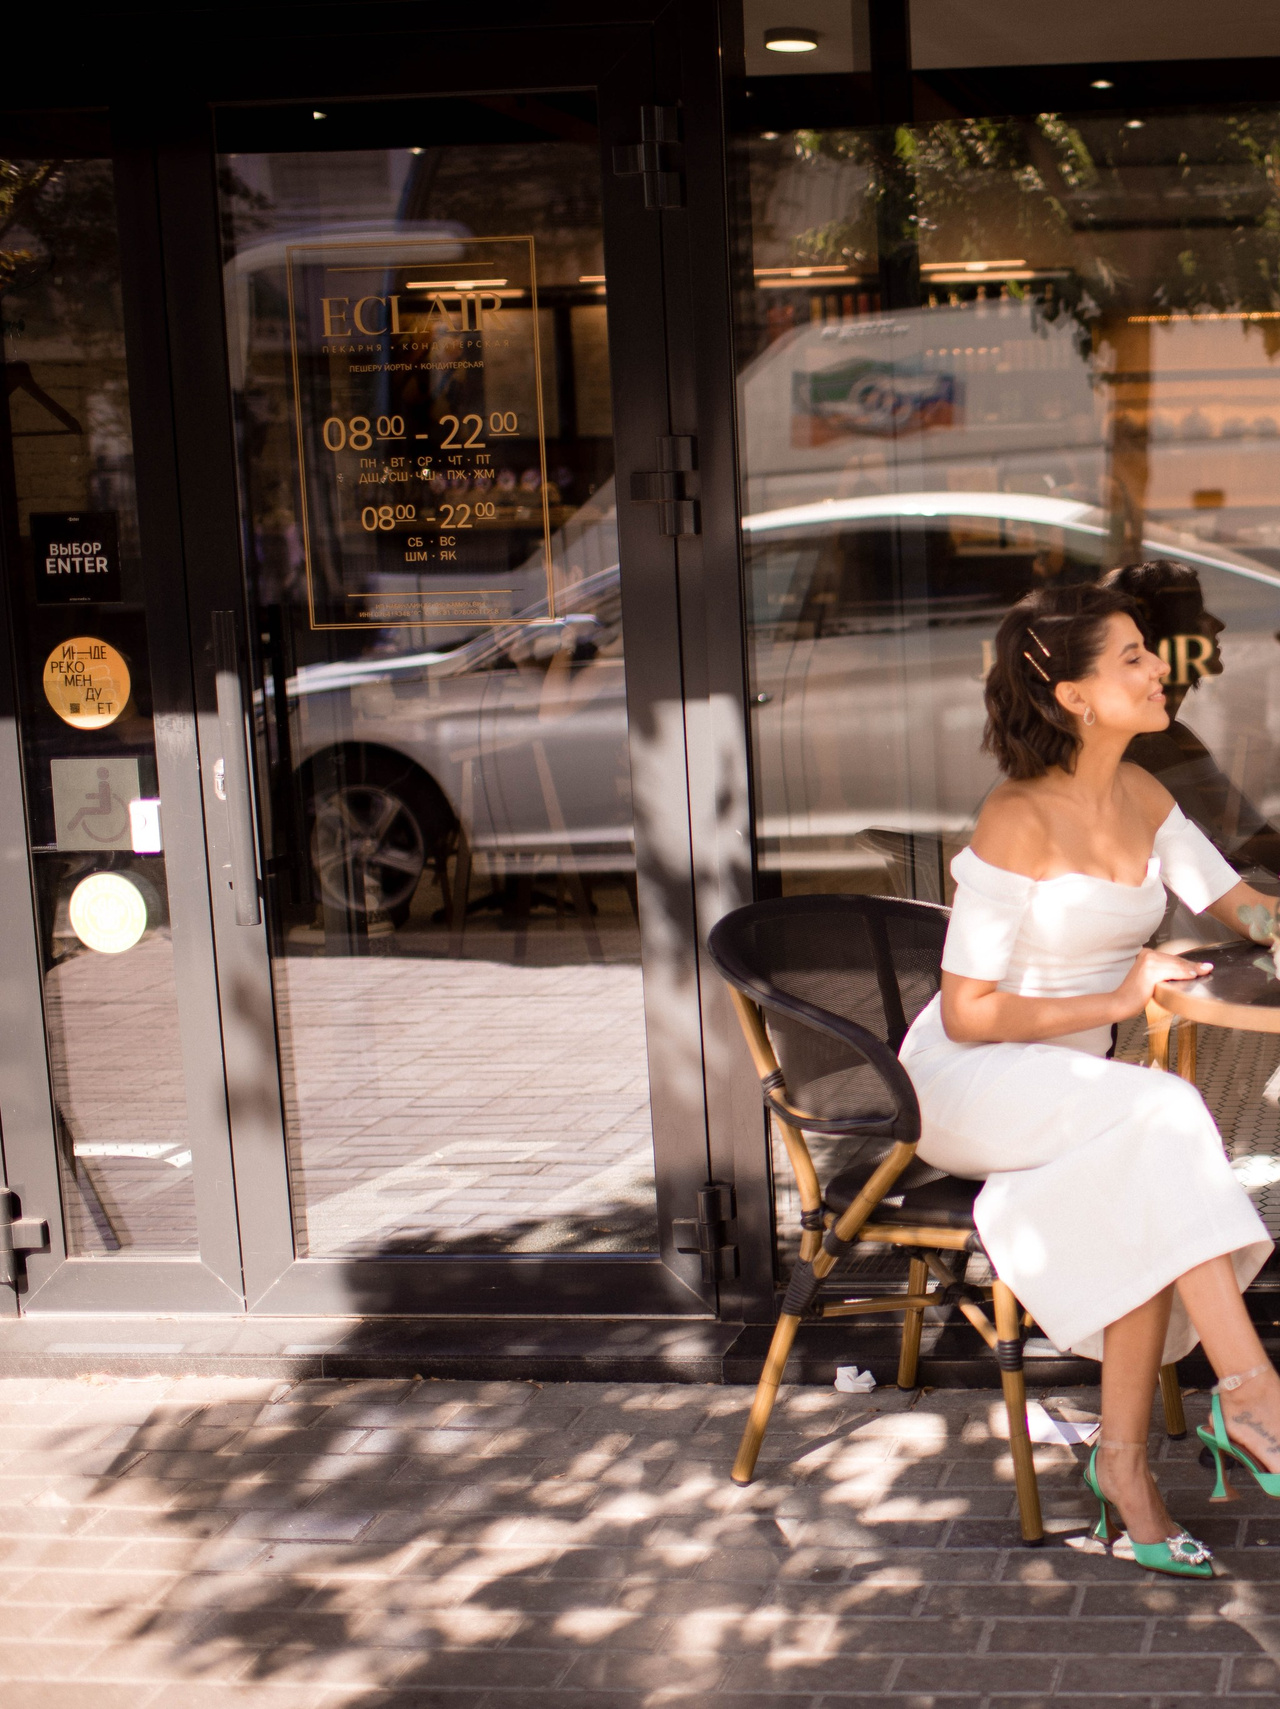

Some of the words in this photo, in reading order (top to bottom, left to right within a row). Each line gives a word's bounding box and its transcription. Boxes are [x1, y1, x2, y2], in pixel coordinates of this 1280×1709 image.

[320, 290, 506, 338] ECLAIR
[322, 344, 382, 353] ПЕКАРНЯ
[360, 458, 377, 468] ПН
[390, 457, 405, 467] ВТ
[417, 456, 433, 467] СР
[448, 454, 463, 466] ЧТ
[476, 454, 491, 465] ПТ
[407, 537, 423, 548] СБ
[439, 536, 456, 547] ВС
[49, 542, 101, 556] ВЫБОР
[405, 552, 428, 562] ШМ
[440, 550, 457, 561] ЯК
[45, 557, 109, 574] ENTER
[50, 661, 85, 673] РЕКО
[64, 674, 92, 687] МЕН
[85, 688, 102, 702] ДУ
[97, 702, 113, 715] ЕТ
